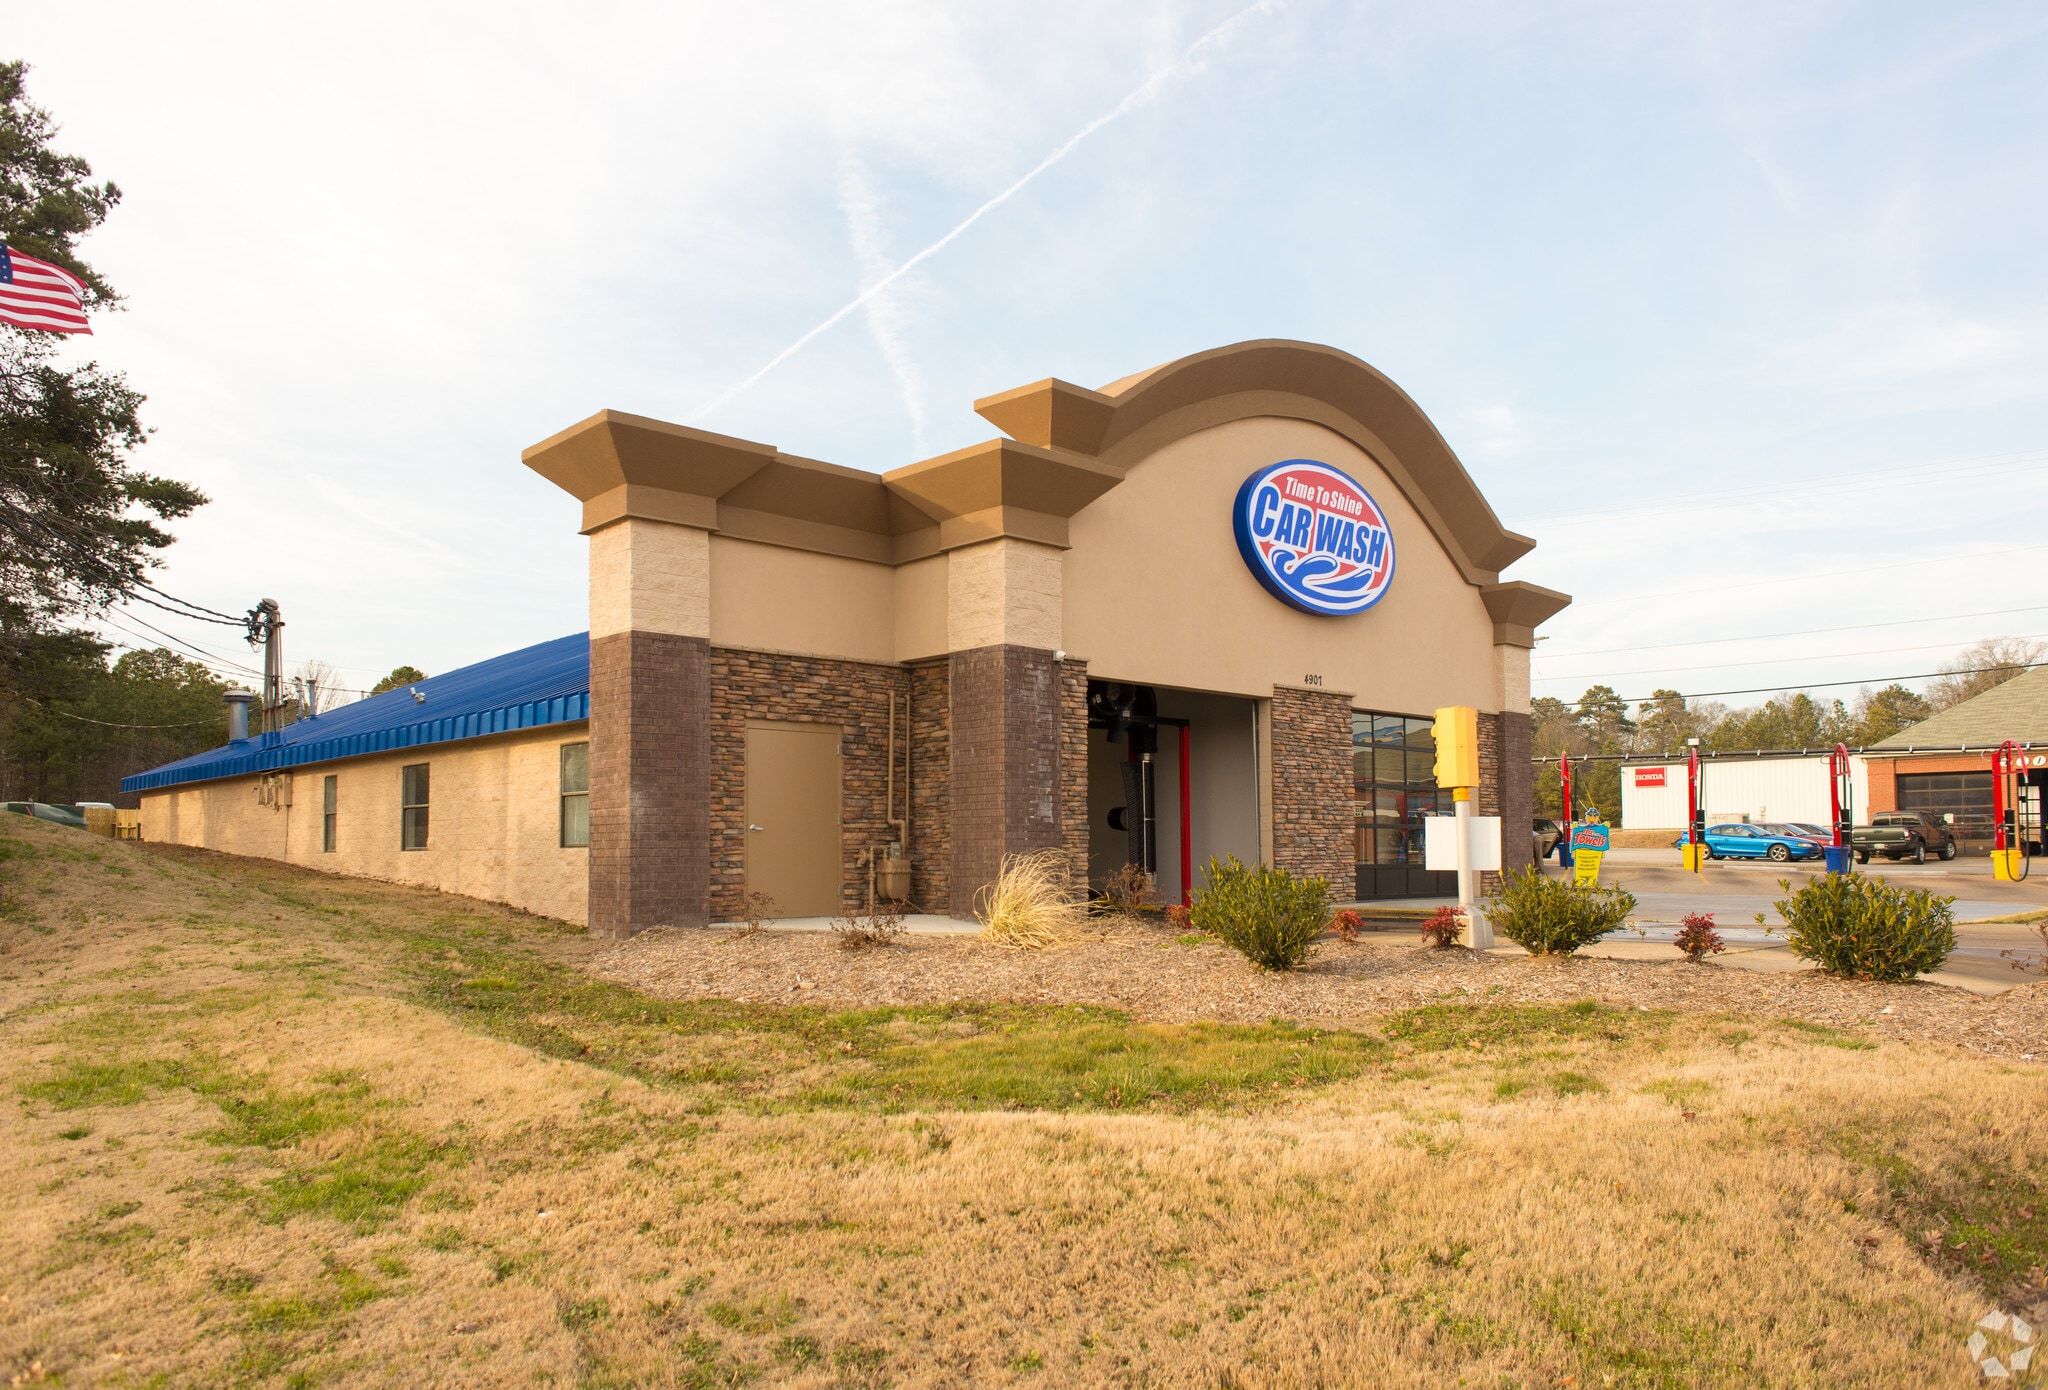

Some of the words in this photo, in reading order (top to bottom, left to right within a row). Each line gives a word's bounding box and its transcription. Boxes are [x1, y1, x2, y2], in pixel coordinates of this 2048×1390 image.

[1285, 476, 1315, 502] Time
[1315, 485, 1329, 506] To
[1329, 490, 1363, 516] Shine
[1252, 485, 1312, 549] CAR
[1314, 512, 1386, 568] WASH
[1304, 674, 1322, 686] 4901
[1574, 832, 1605, 846] Towels
